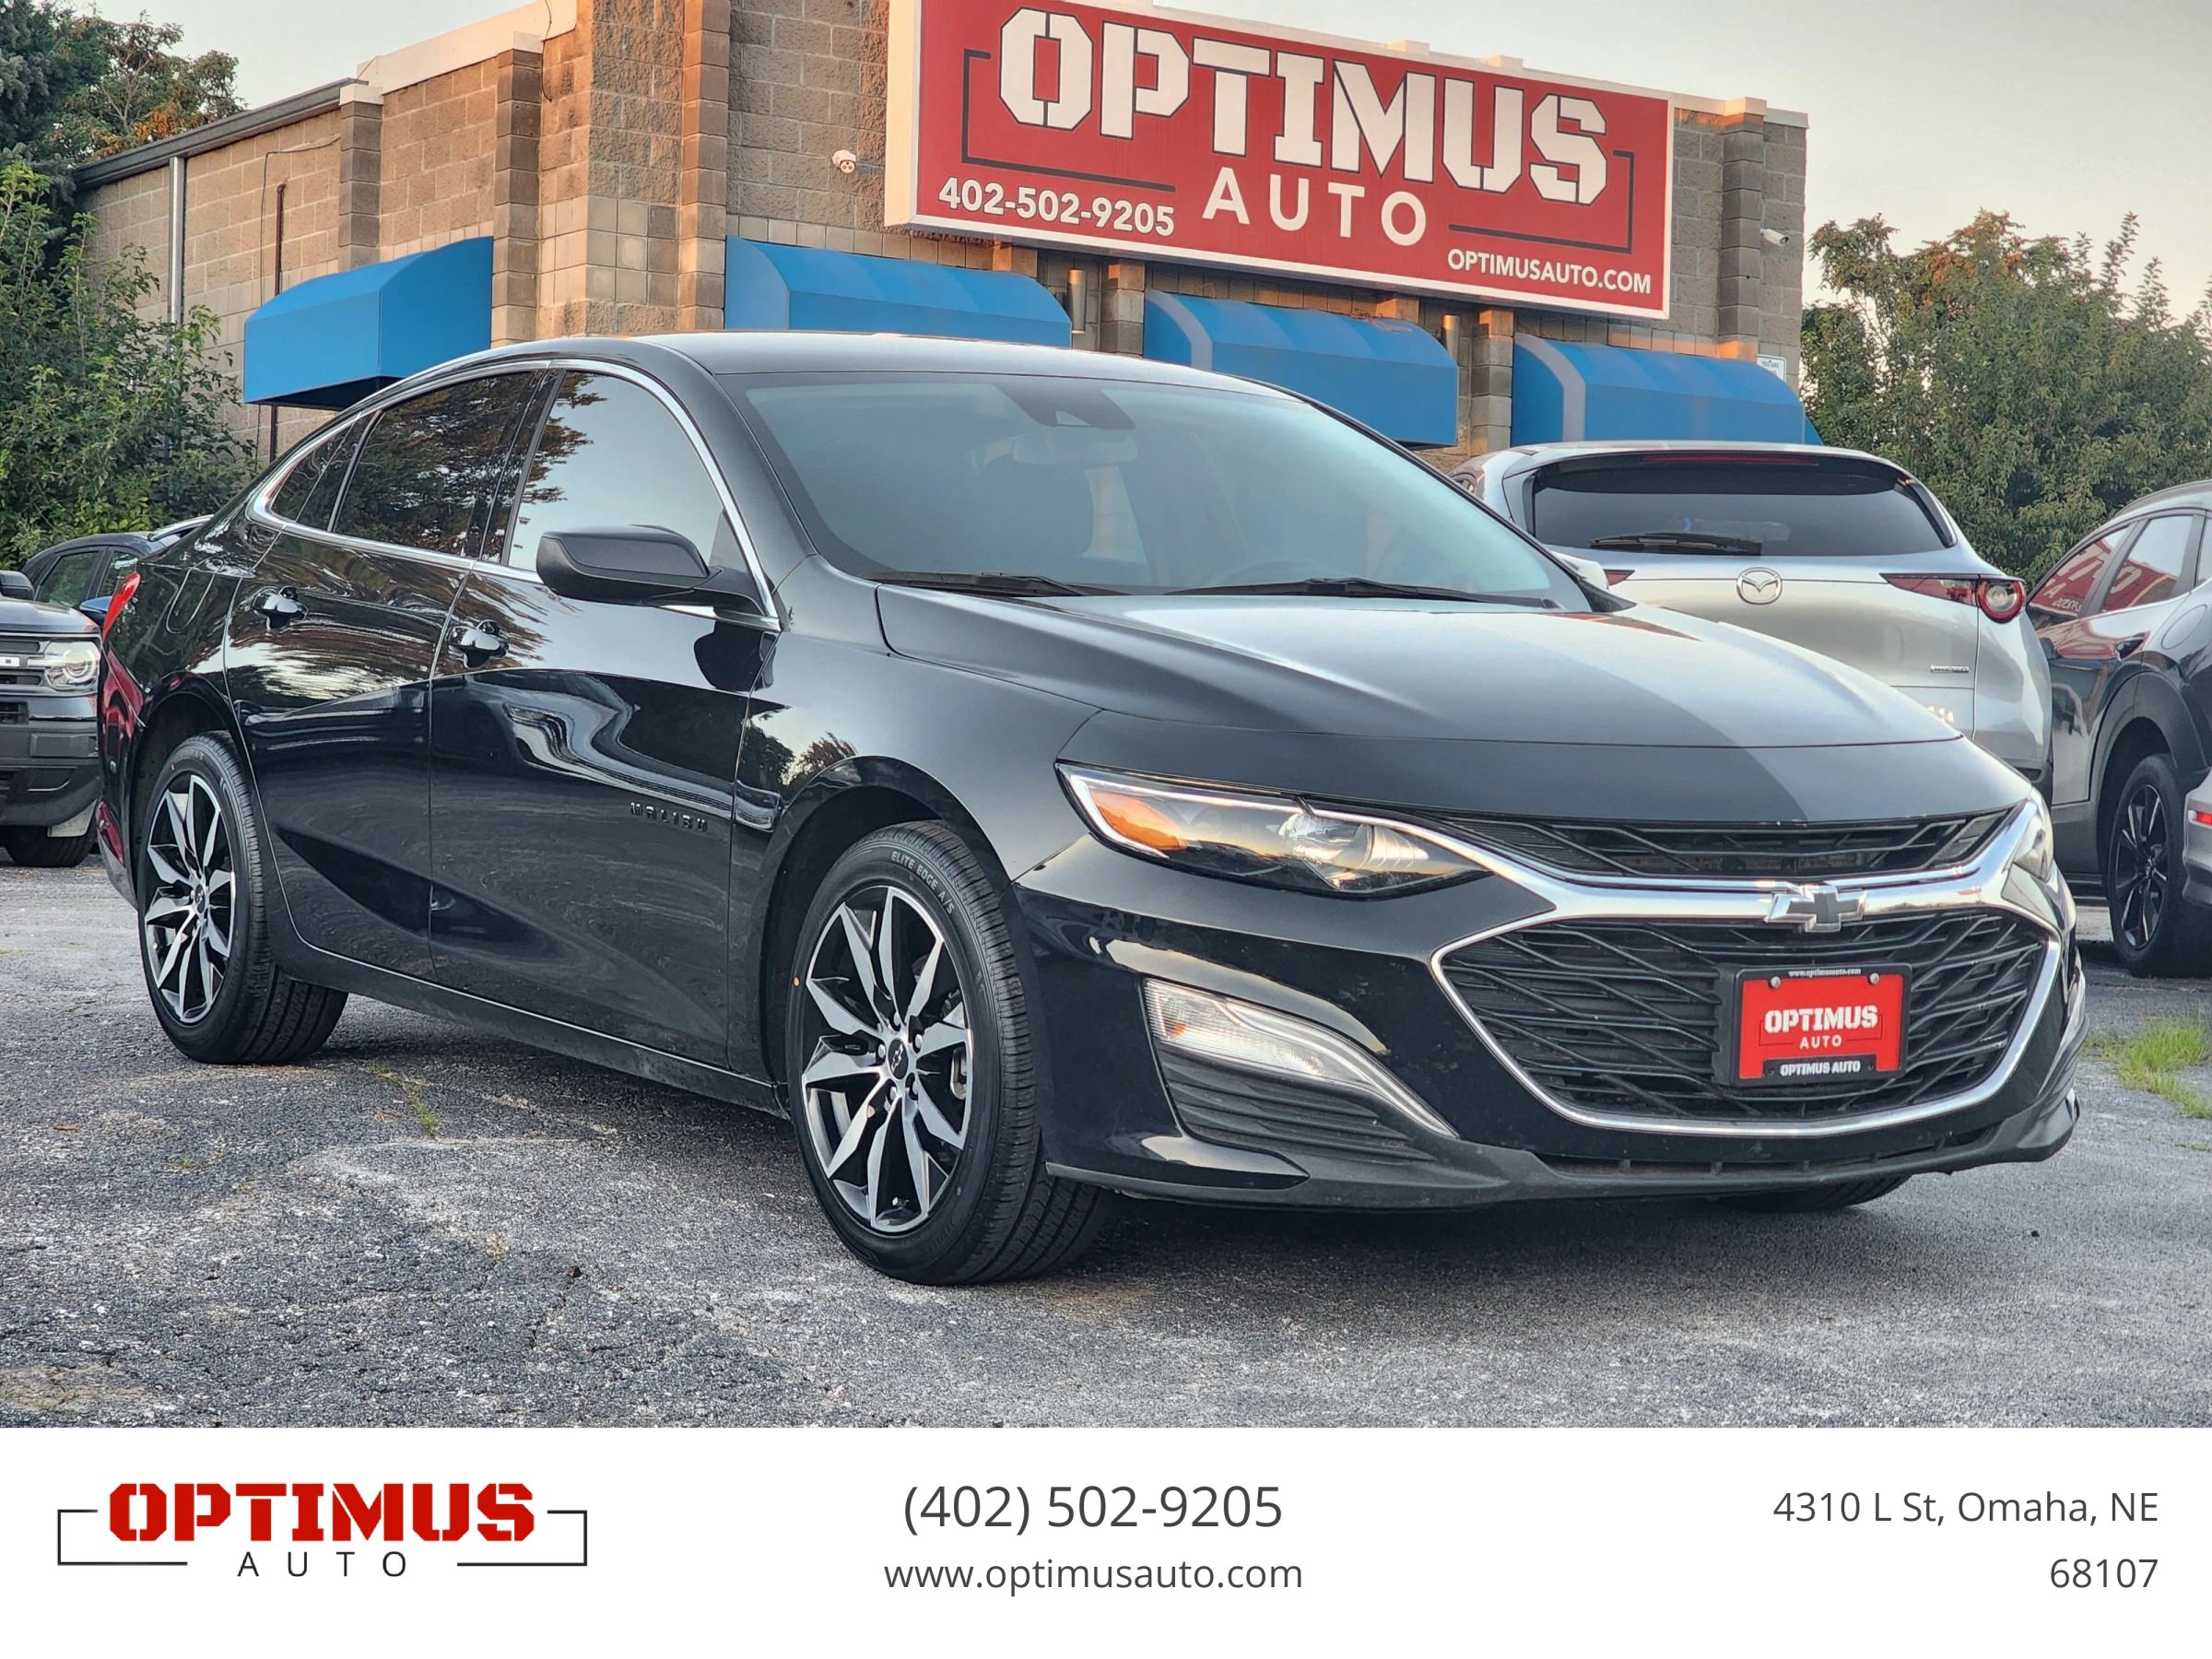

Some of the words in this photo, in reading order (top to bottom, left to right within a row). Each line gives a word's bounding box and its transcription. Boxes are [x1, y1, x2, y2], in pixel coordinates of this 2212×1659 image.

[999, 7, 1607, 206] OPTIMUS
[938, 177, 1175, 236] 402-502-9205
[1202, 167, 1427, 246] AUTO
[1447, 248, 1652, 294] OPTIMUSAUTO.COM
[891, 851, 915, 870] ELITE
[916, 865, 938, 890] EDGE
[937, 891, 955, 914] A/S
[1788, 968, 1862, 978] www.optimusauto.com
[1764, 1005, 1877, 1033] OPTIMUS
[1799, 1035, 1842, 1050] AUTO
[1780, 1062, 1830, 1077] OPTIMUS
[1831, 1060, 1861, 1074] AUTO
